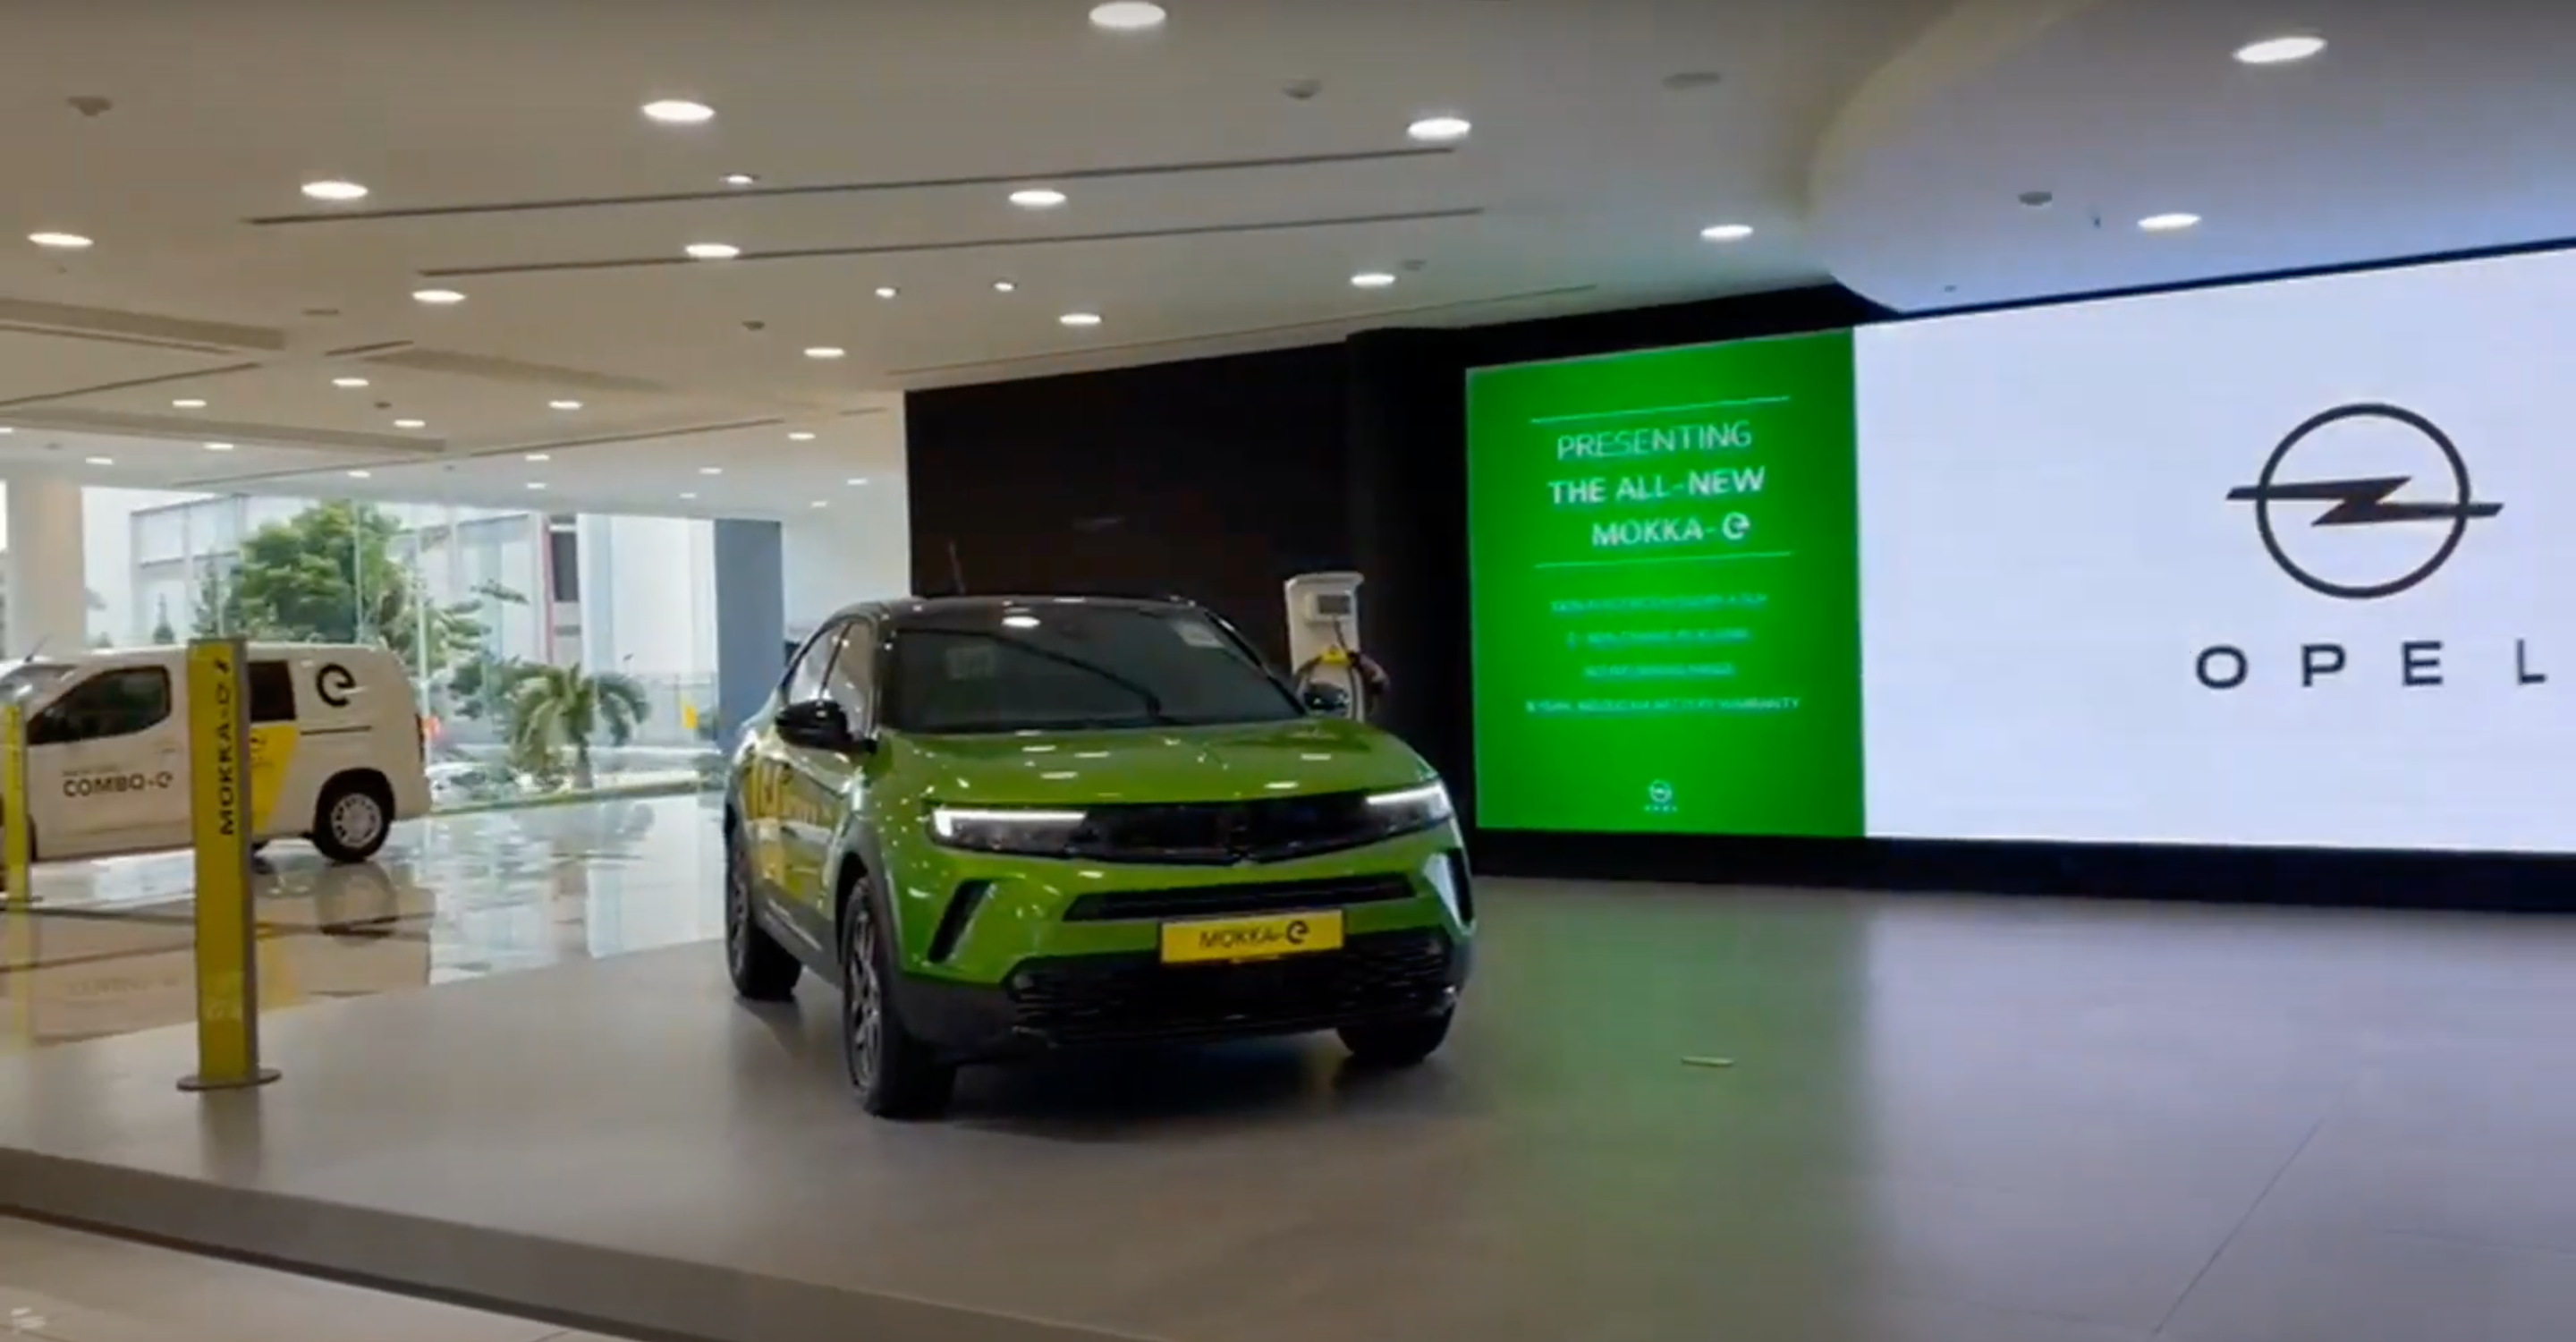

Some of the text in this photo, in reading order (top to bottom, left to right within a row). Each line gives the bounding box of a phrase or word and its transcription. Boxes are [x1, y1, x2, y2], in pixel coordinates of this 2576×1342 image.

[1556, 420, 1752, 460] PRESENTING
[1547, 466, 1766, 504] THE ALL-NEW
[2195, 640, 2547, 689] OPEL
